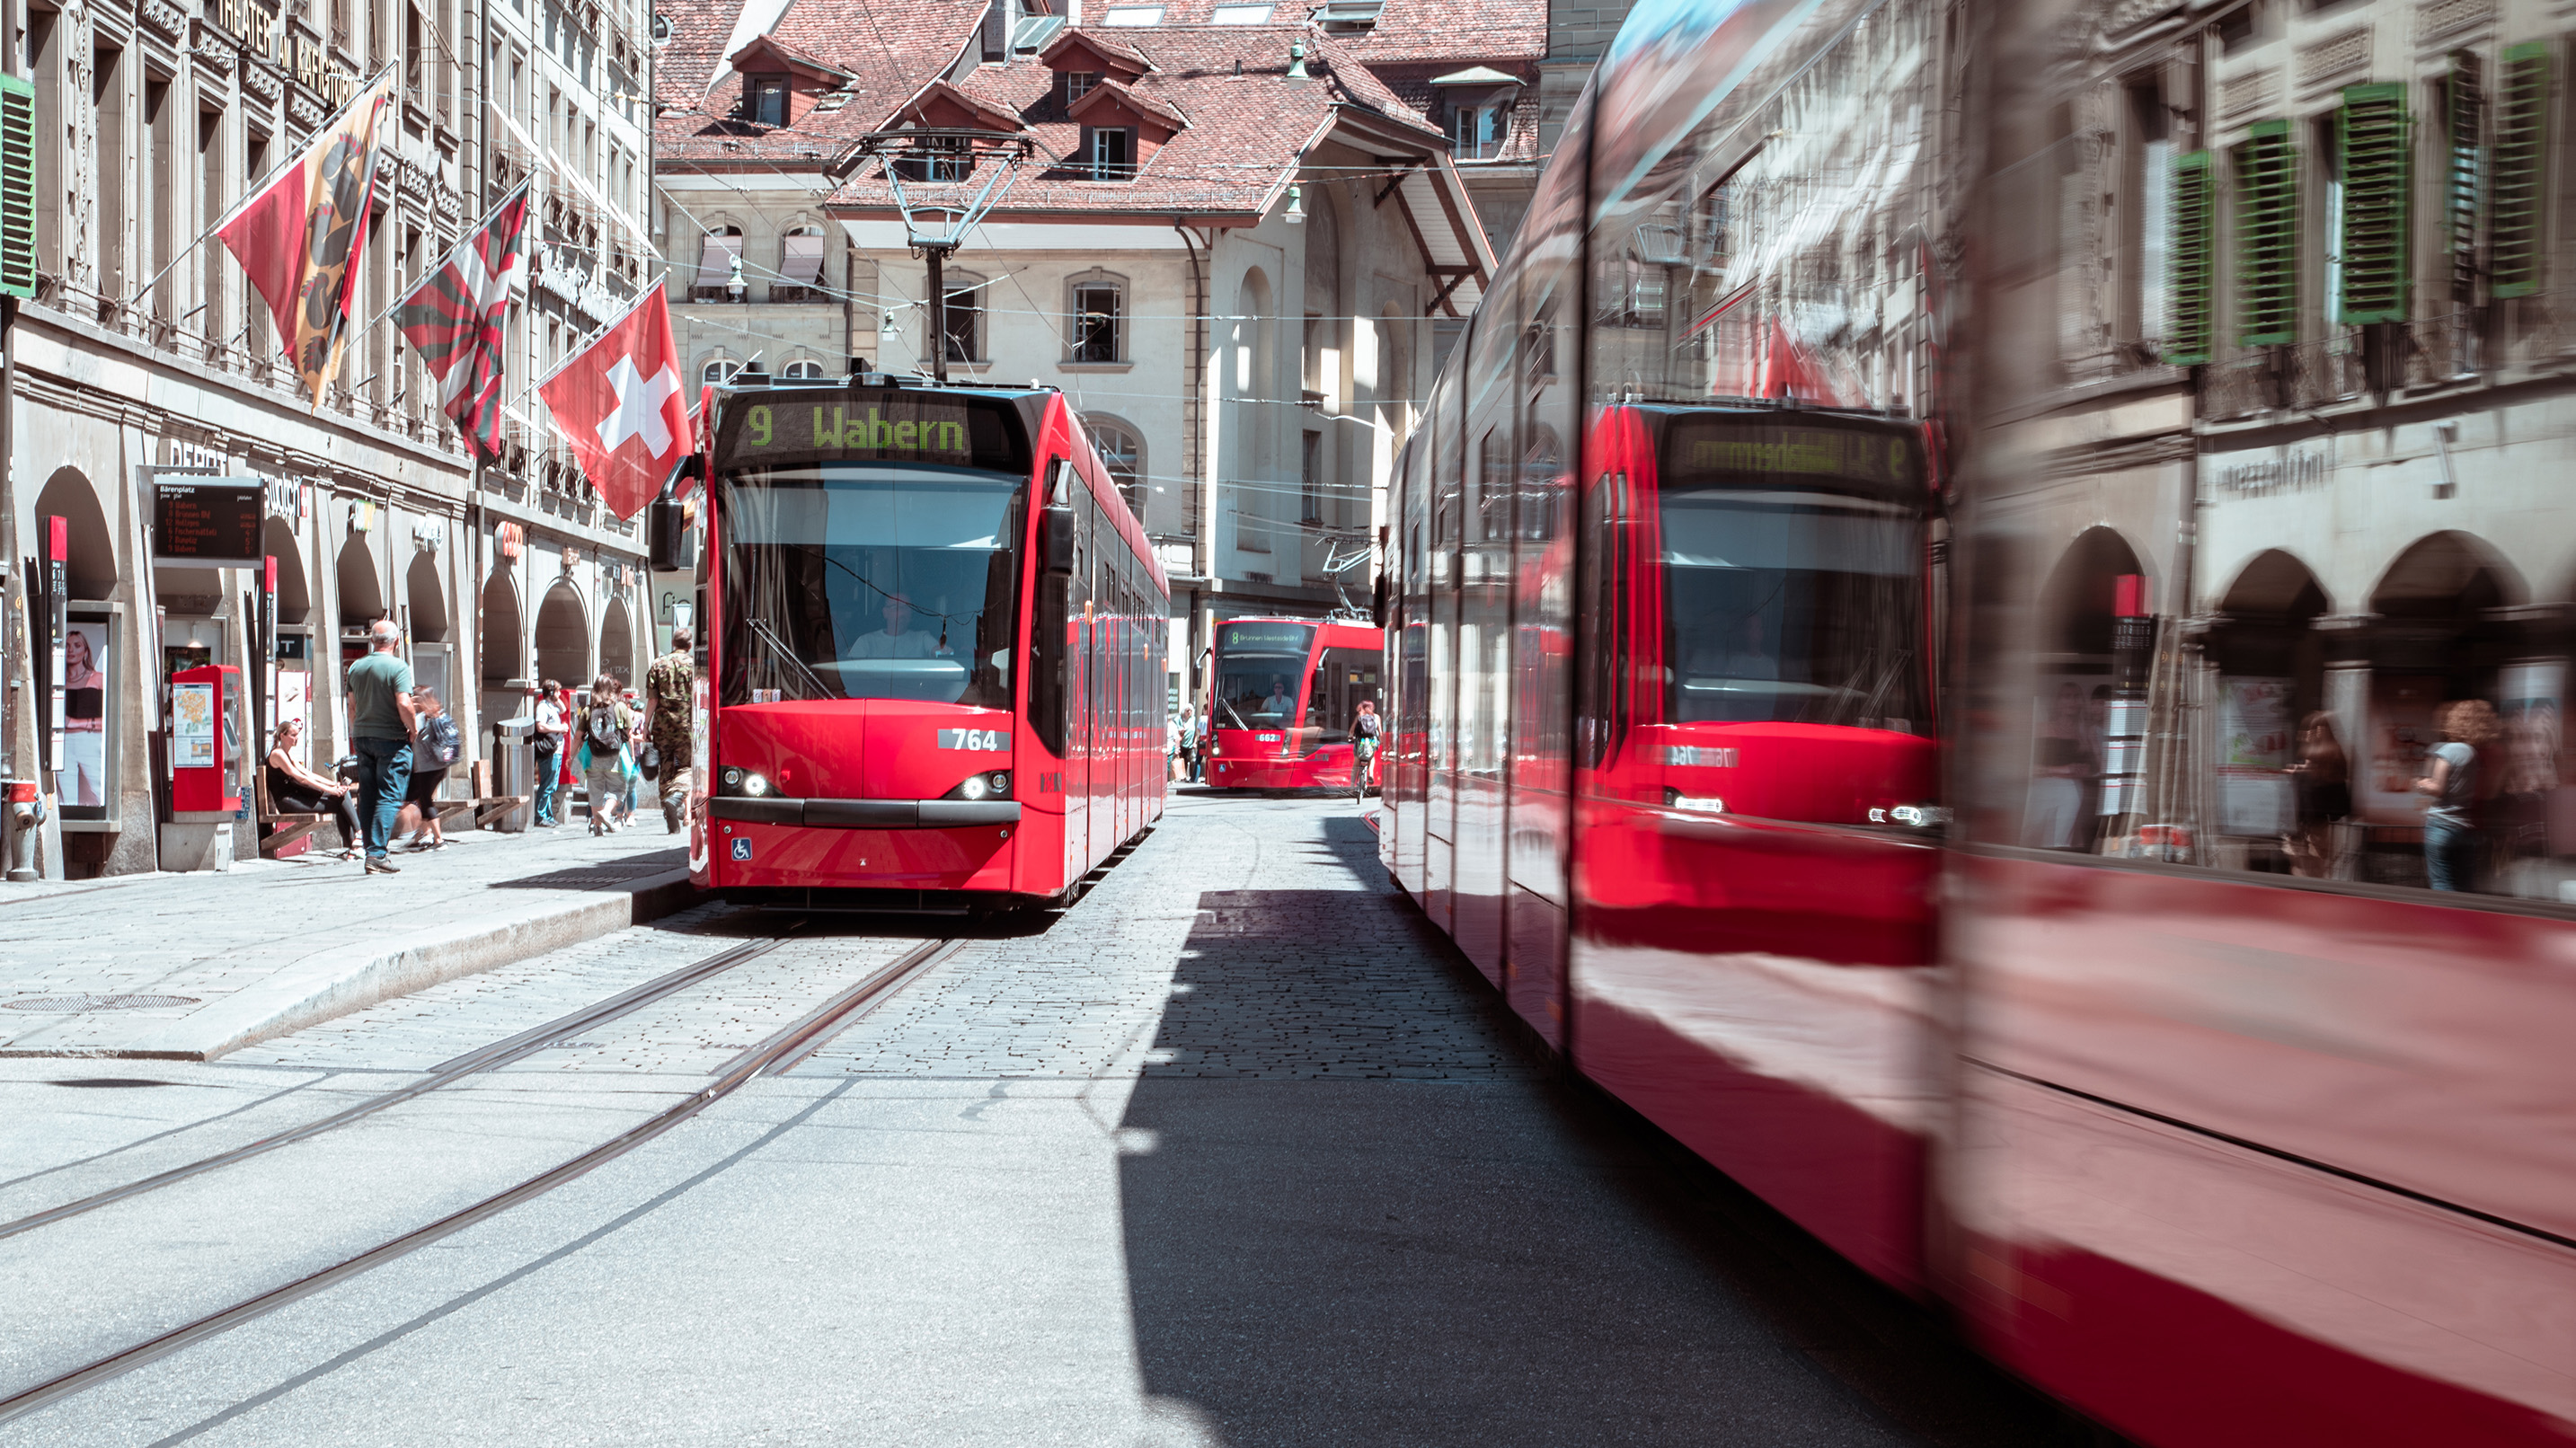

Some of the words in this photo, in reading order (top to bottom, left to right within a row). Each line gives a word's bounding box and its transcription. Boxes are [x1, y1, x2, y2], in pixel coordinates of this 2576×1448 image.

[278, 34, 292, 74] AM
[748, 405, 772, 446] 9
[813, 407, 963, 450] Wabern
[1232, 632, 1239, 645] 8
[952, 728, 998, 751] 764
[1259, 733, 1276, 742] 662
